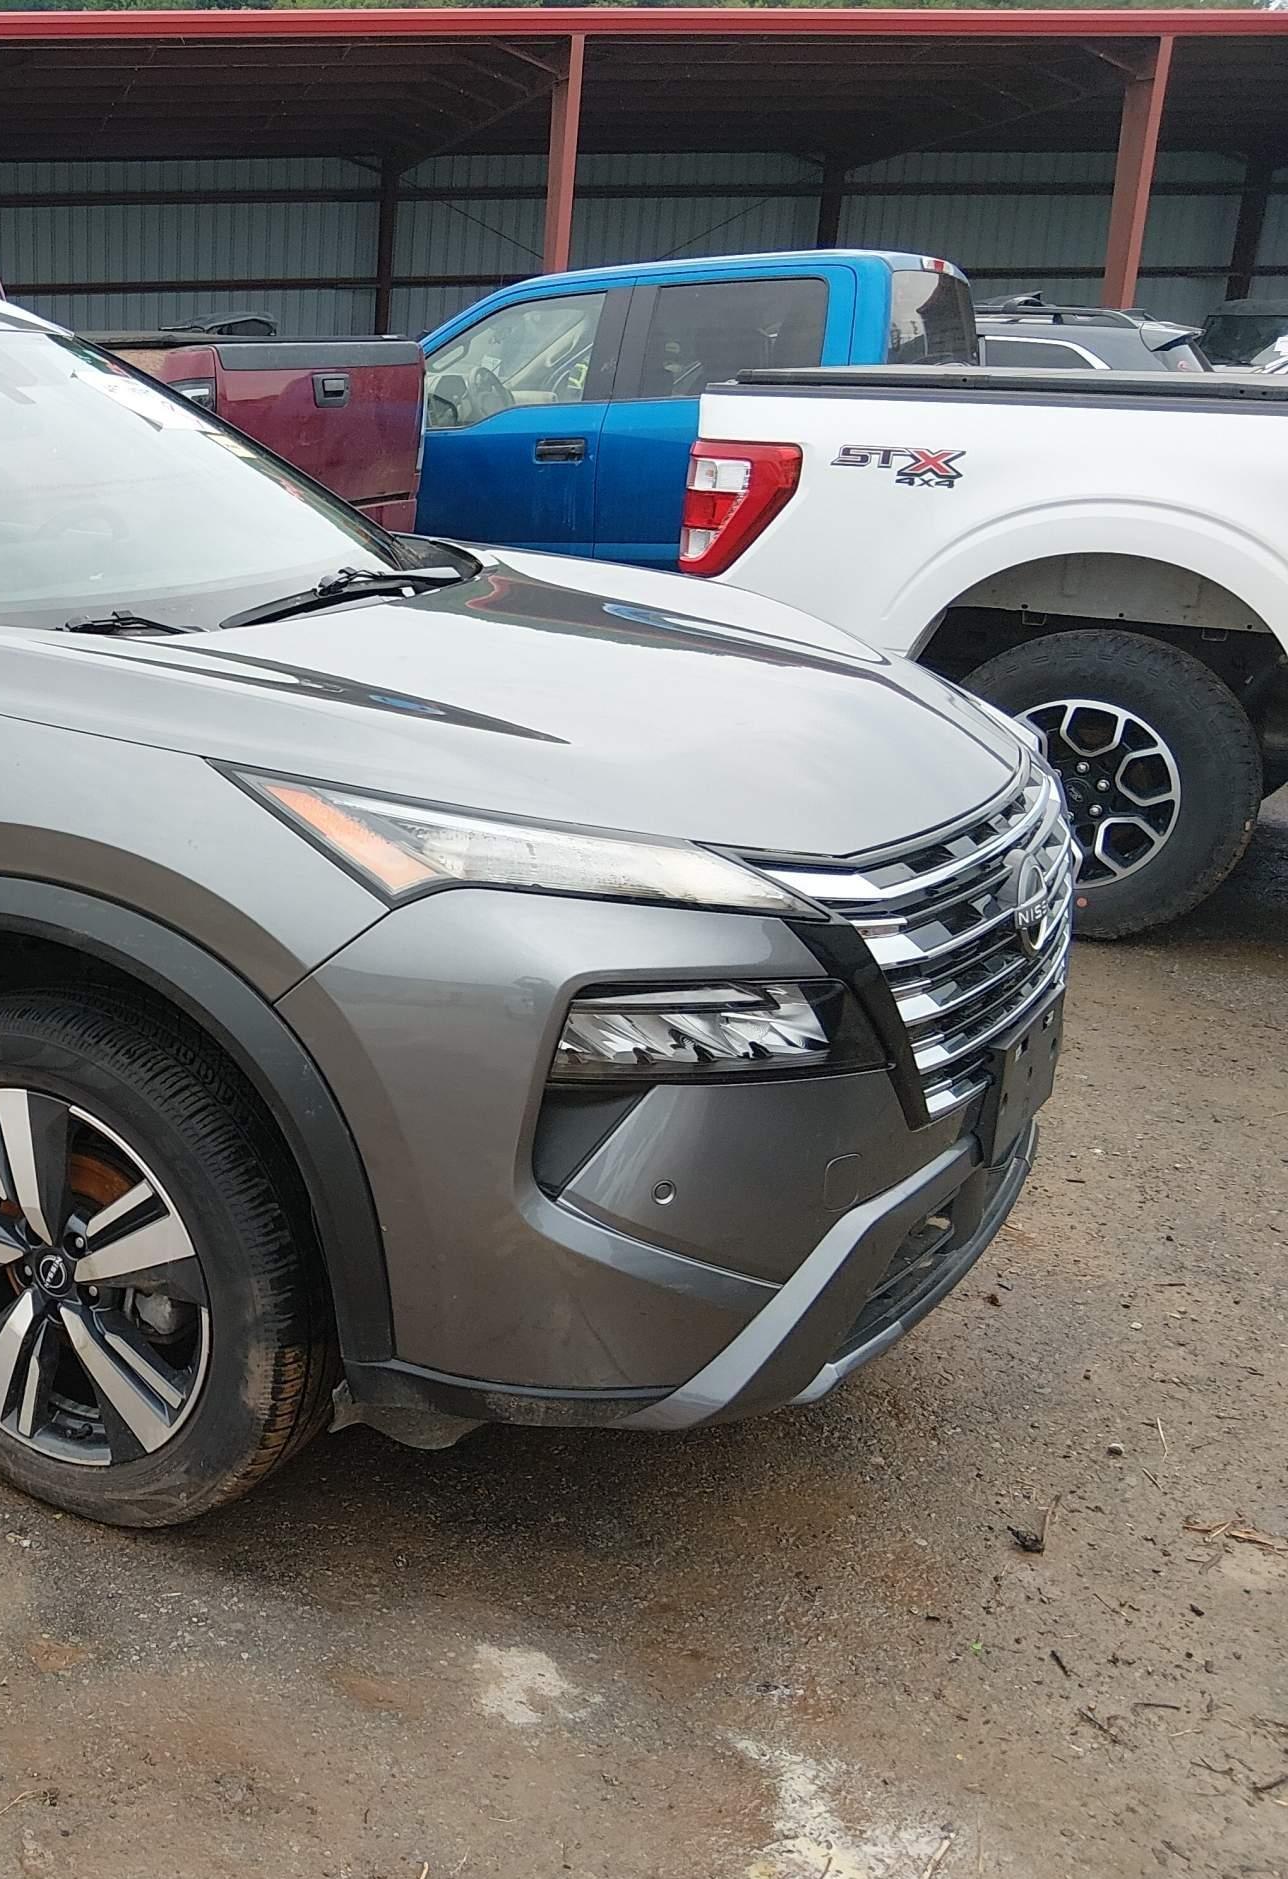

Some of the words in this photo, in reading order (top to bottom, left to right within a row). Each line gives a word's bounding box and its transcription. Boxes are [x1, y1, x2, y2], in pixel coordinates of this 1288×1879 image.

[831, 445, 966, 479] STX
[1018, 899, 1047, 926] NISS
[44, 1256, 63, 1288] NISSAN
